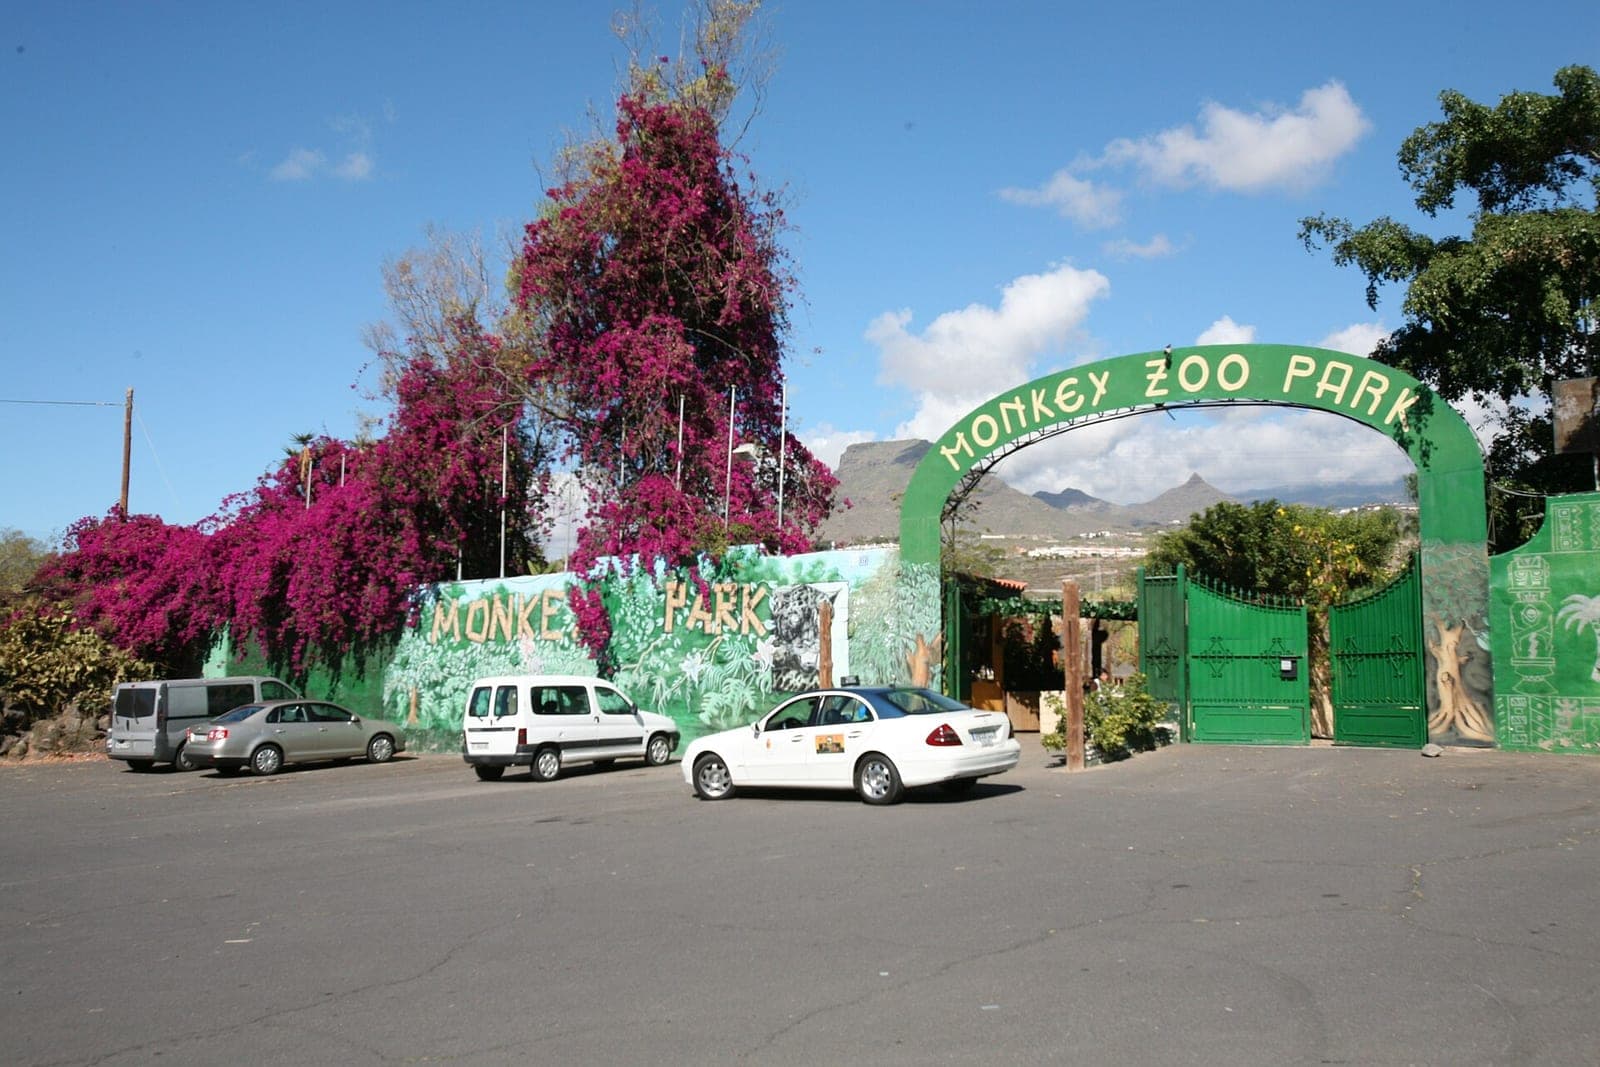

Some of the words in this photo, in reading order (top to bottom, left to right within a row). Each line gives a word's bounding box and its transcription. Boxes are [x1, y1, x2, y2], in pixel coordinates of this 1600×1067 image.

[939, 371, 1109, 471] MONKEY
[1144, 353, 1250, 397] ZOO
[1282, 354, 1420, 432] PARK
[431, 589, 580, 644] MONKE
[664, 581, 767, 637] PARK
